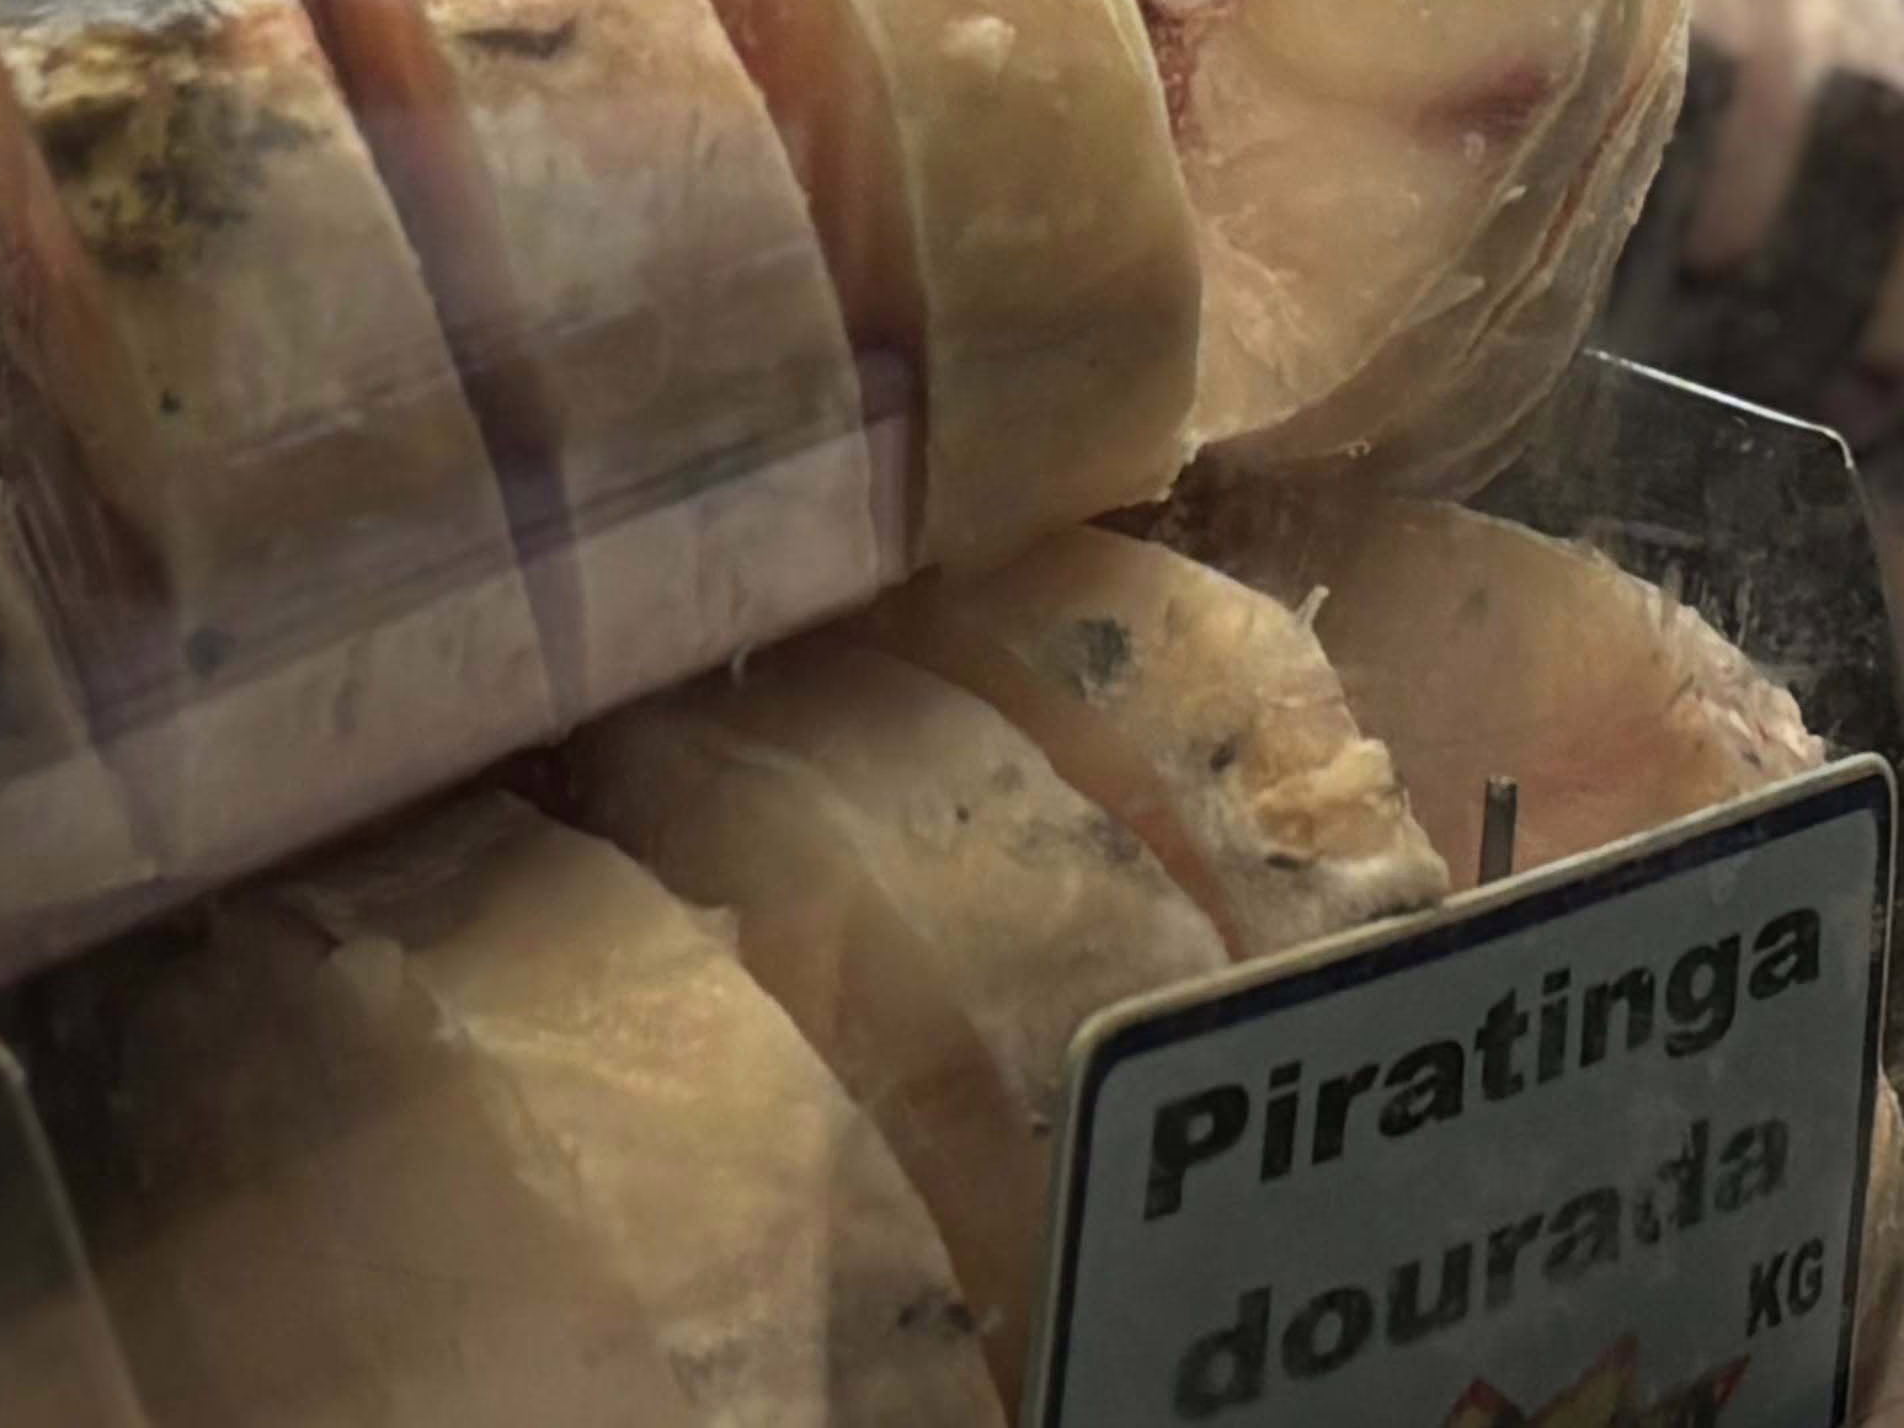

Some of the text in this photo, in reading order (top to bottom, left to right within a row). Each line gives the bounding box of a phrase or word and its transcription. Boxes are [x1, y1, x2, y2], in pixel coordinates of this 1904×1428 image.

[1142, 905, 1823, 1222] Piratinga
[1170, 1110, 1791, 1421] dourada
[1744, 1239, 1824, 1338] KG
